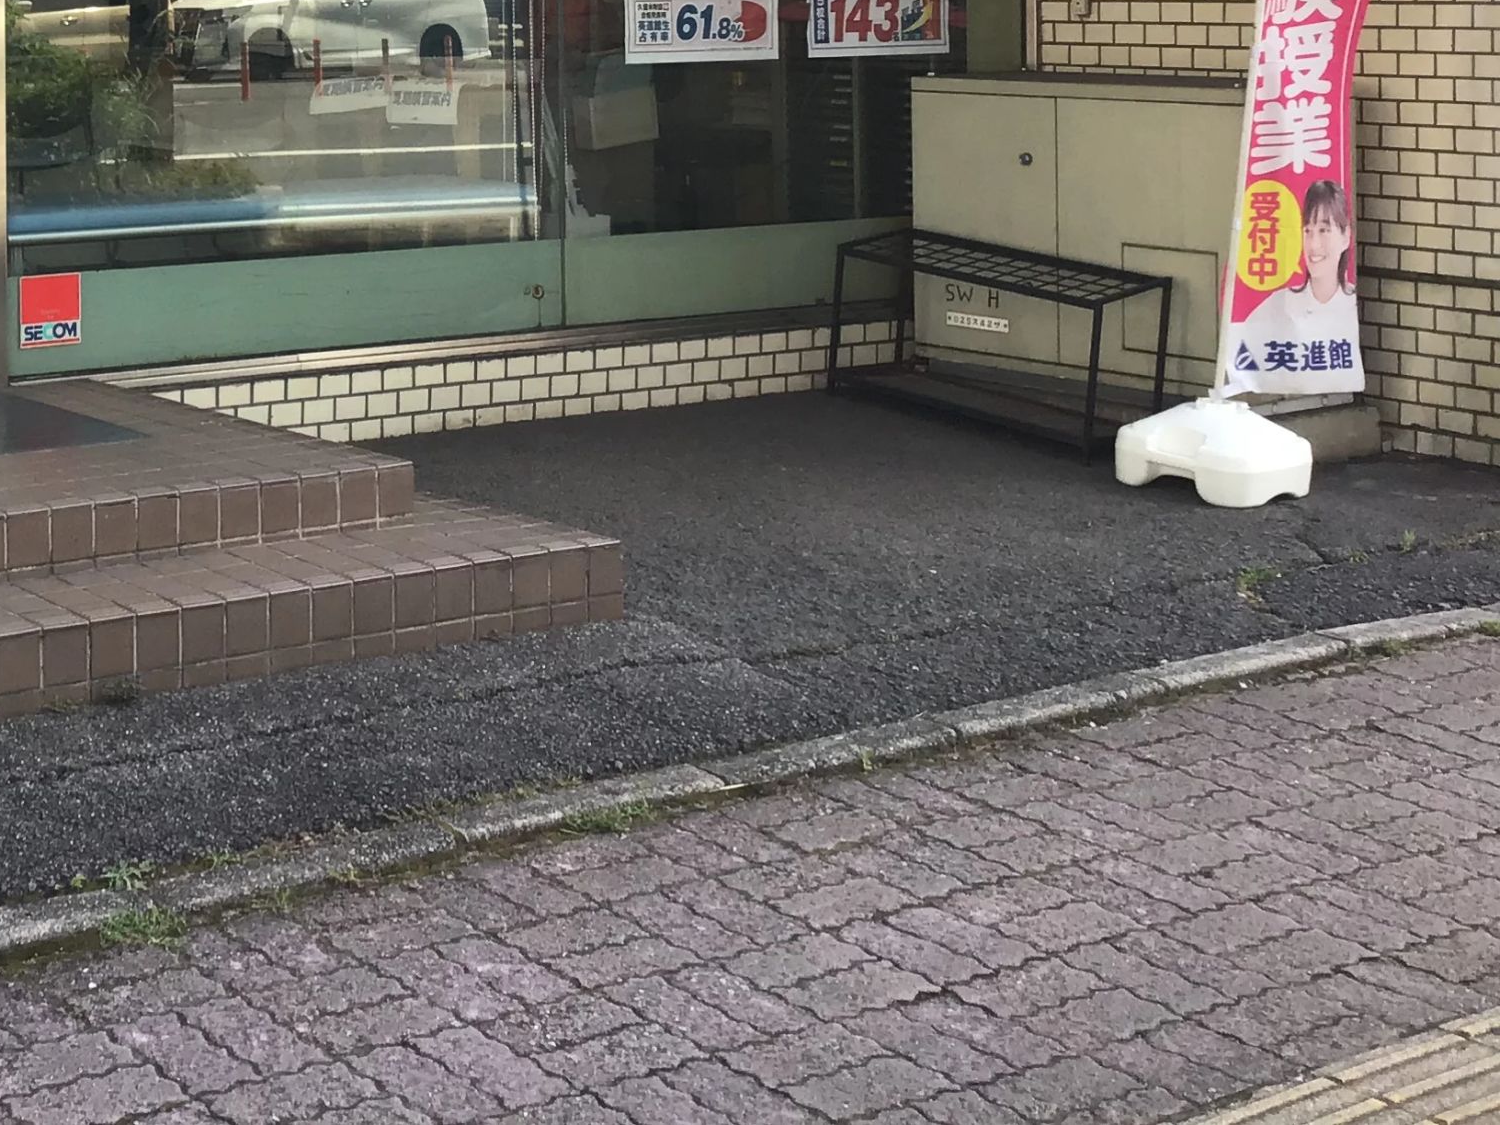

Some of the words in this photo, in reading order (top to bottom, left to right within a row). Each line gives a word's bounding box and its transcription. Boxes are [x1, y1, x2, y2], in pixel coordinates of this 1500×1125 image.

[676, 4, 744, 42] 61.8%
[1247, 191, 1281, 286] 受付中
[945, 283, 974, 303] SW
[987, 288, 999, 309] H
[24, 322, 77, 342] SECOM
[1263, 338, 1353, 372] 英進館
